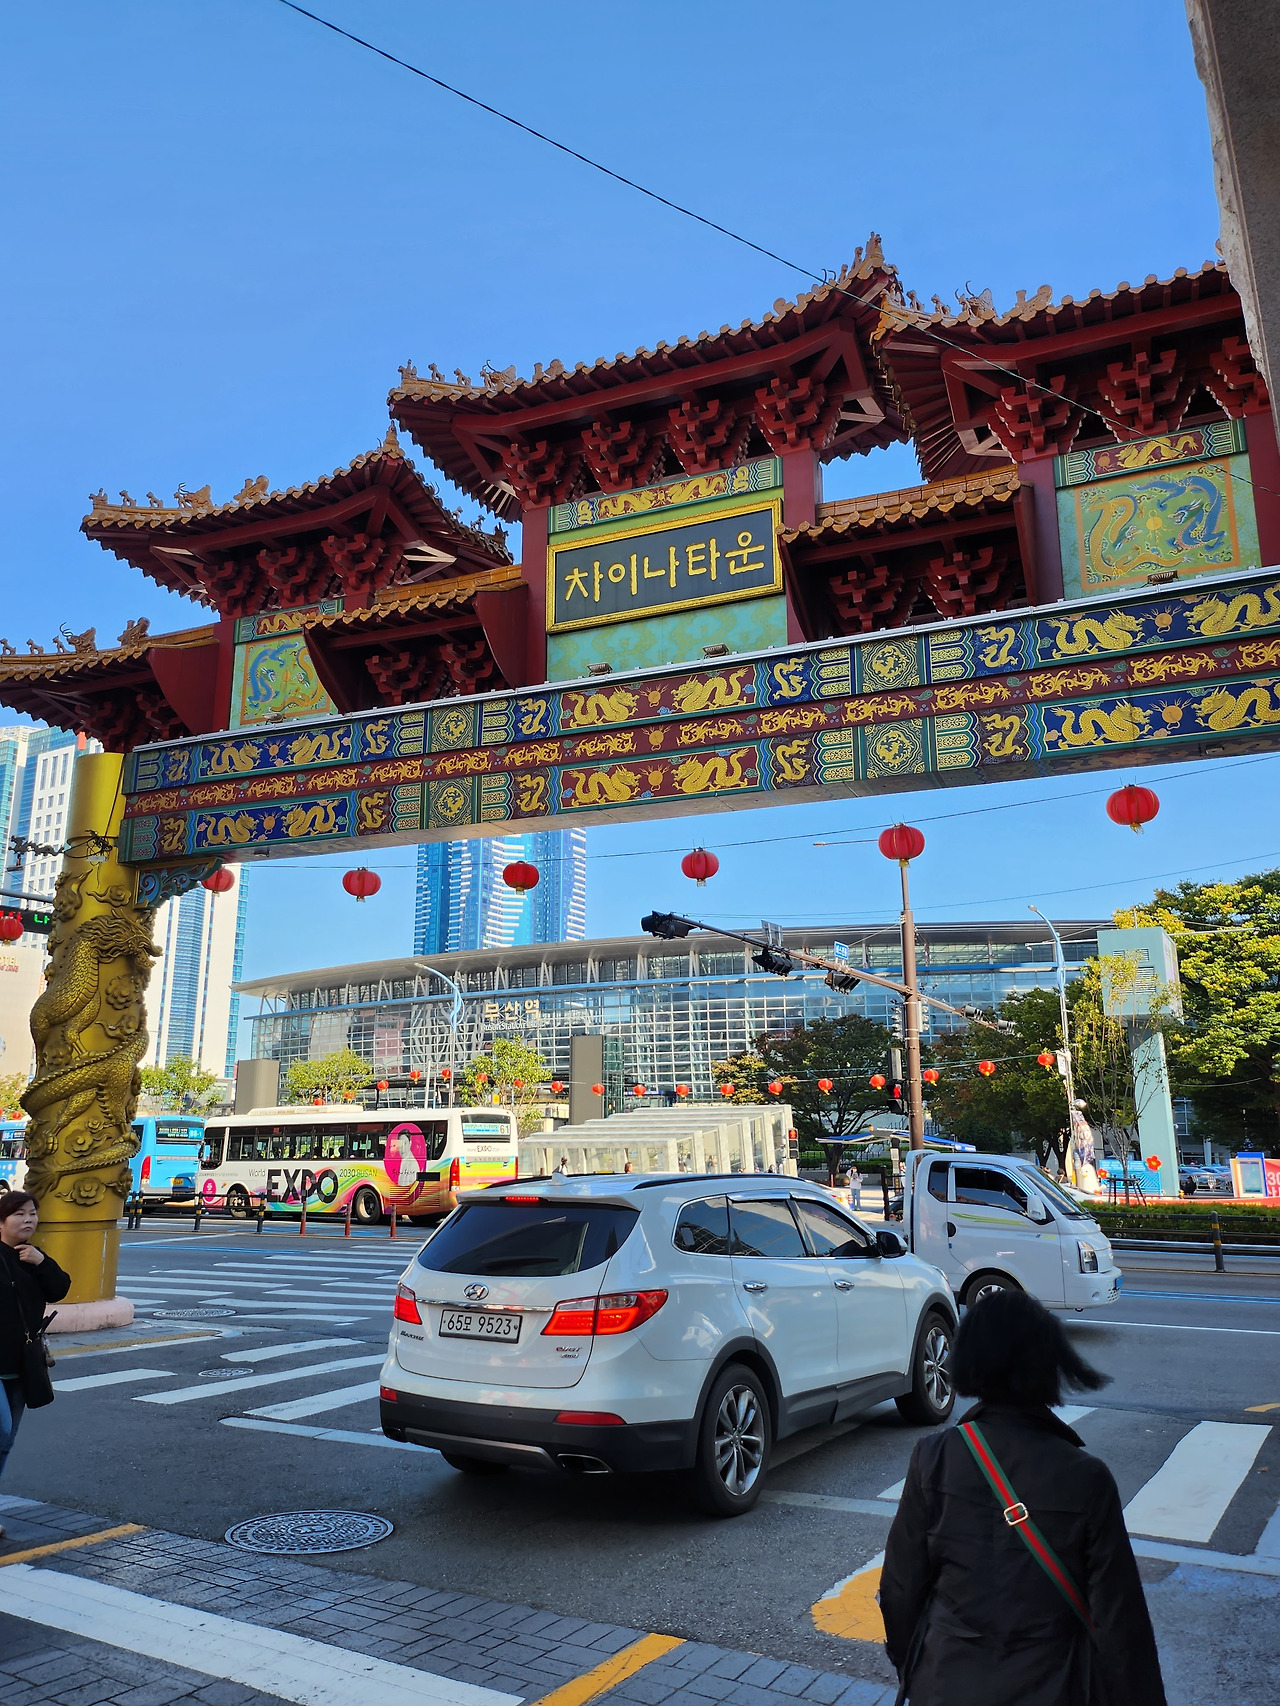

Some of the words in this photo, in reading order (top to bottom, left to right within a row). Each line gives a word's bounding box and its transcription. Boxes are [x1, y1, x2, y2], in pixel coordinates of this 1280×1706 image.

[564, 531, 765, 603] 차이나타운
[484, 998, 539, 1021] 부산역
[499, 1125, 510, 1134] 61
[249, 1168, 266, 1177] World
[266, 1168, 339, 1203] EXPO
[339, 1168, 356, 1178] 2030
[356, 1168, 378, 1178] BUSAN
[447, 1314, 472, 1331] 65모
[478, 1316, 513, 1336] 9523
